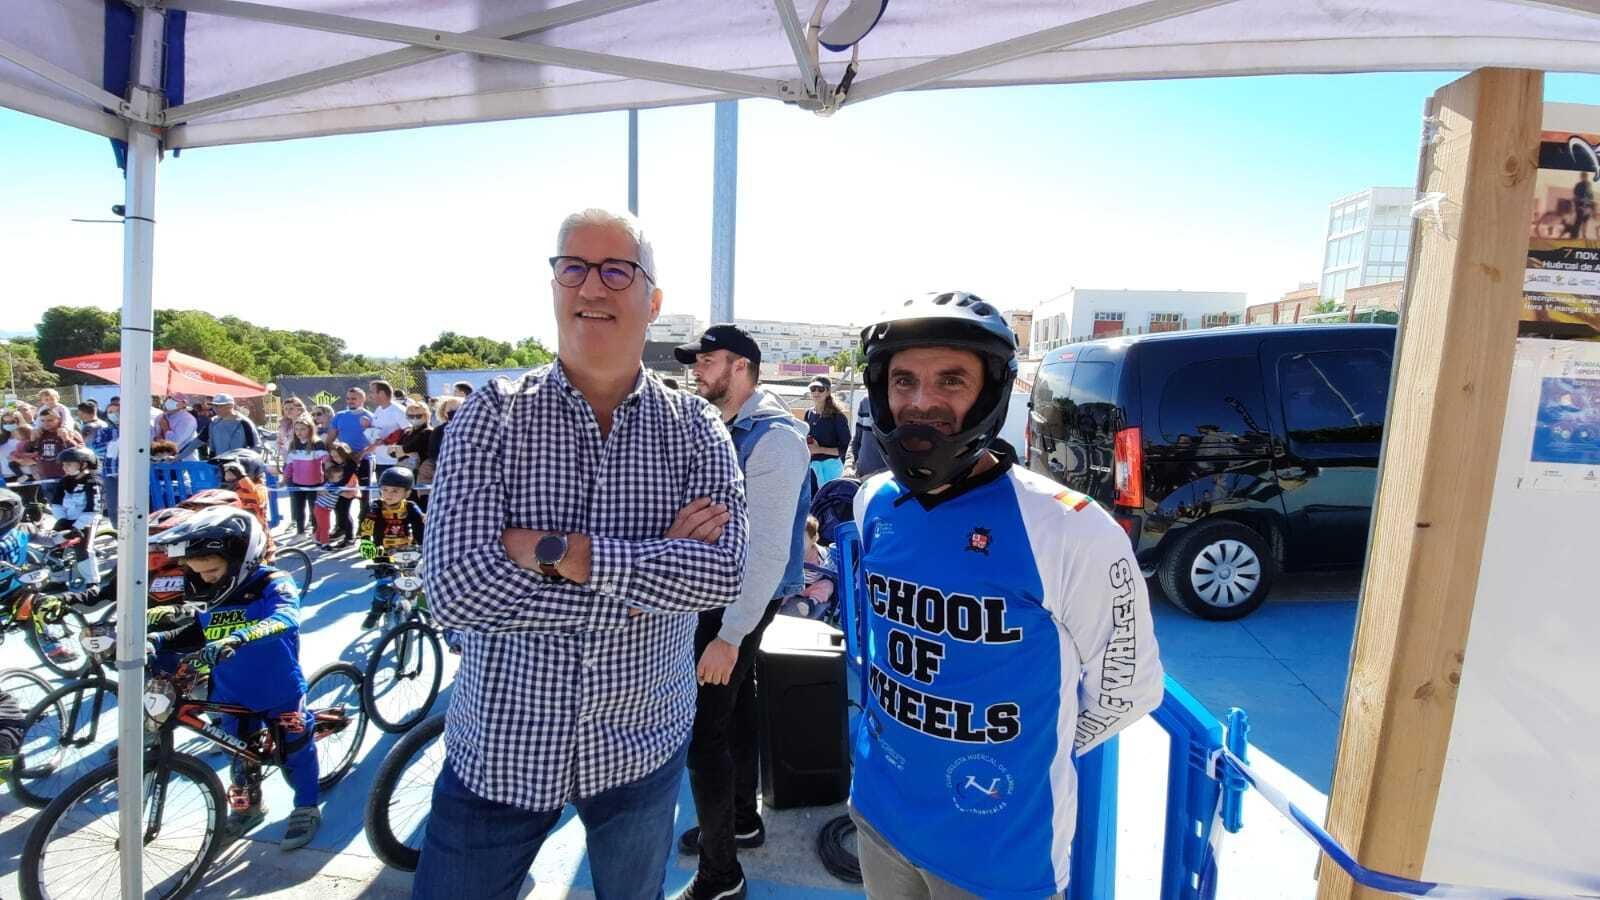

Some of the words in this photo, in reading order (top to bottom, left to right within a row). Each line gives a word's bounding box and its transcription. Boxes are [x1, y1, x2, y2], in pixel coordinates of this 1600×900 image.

[1564, 248, 1573, 258] 7
[1575, 250, 1599, 260] nov.
[865, 569, 1023, 645] CHOOL
[209, 609, 248, 626] BMX
[90, 639, 100, 649] 5
[887, 628, 946, 686] OF
[148, 696, 157, 710] 7
[202, 722, 248, 751] MEYBO
